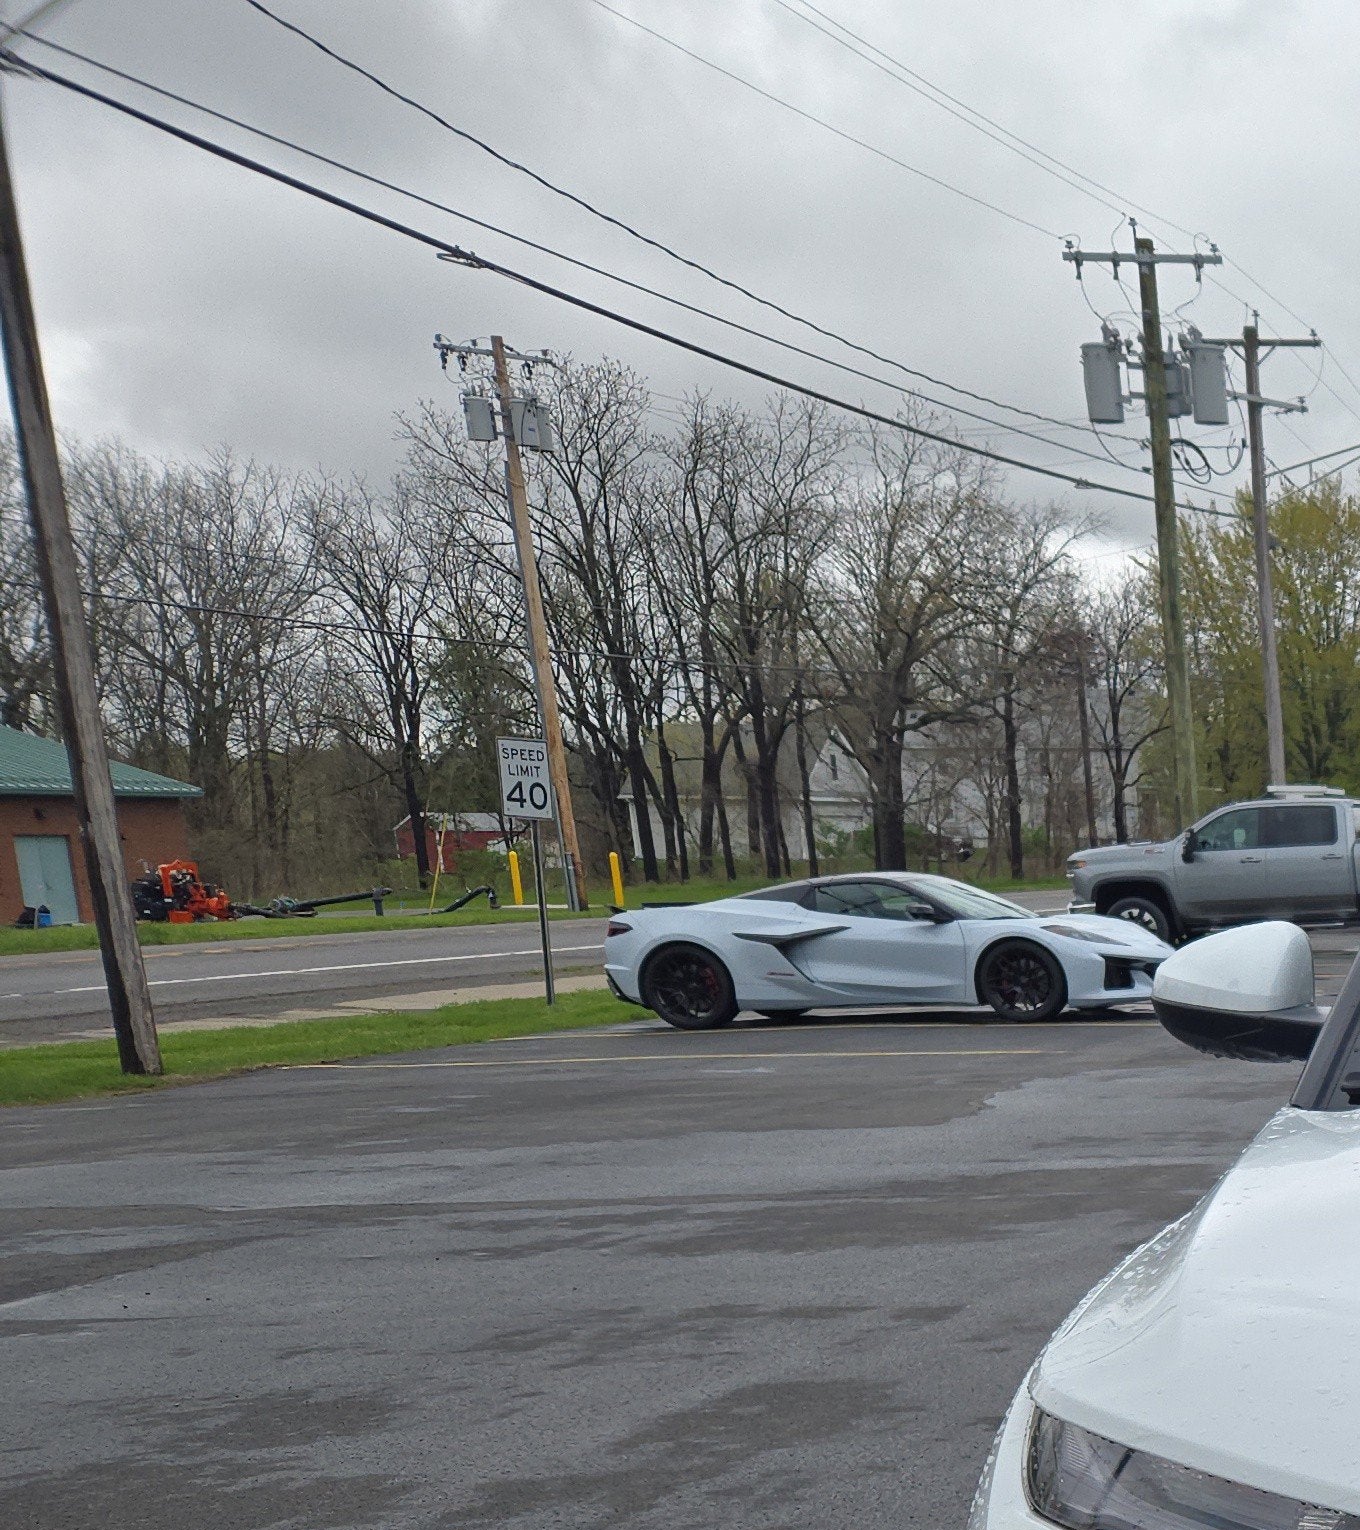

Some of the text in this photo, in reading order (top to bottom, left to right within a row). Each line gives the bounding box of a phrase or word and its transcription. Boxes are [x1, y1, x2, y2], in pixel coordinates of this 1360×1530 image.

[502, 747, 545, 762] SPEED
[508, 763, 541, 778] LIMIT
[506, 780, 548, 811] 40
